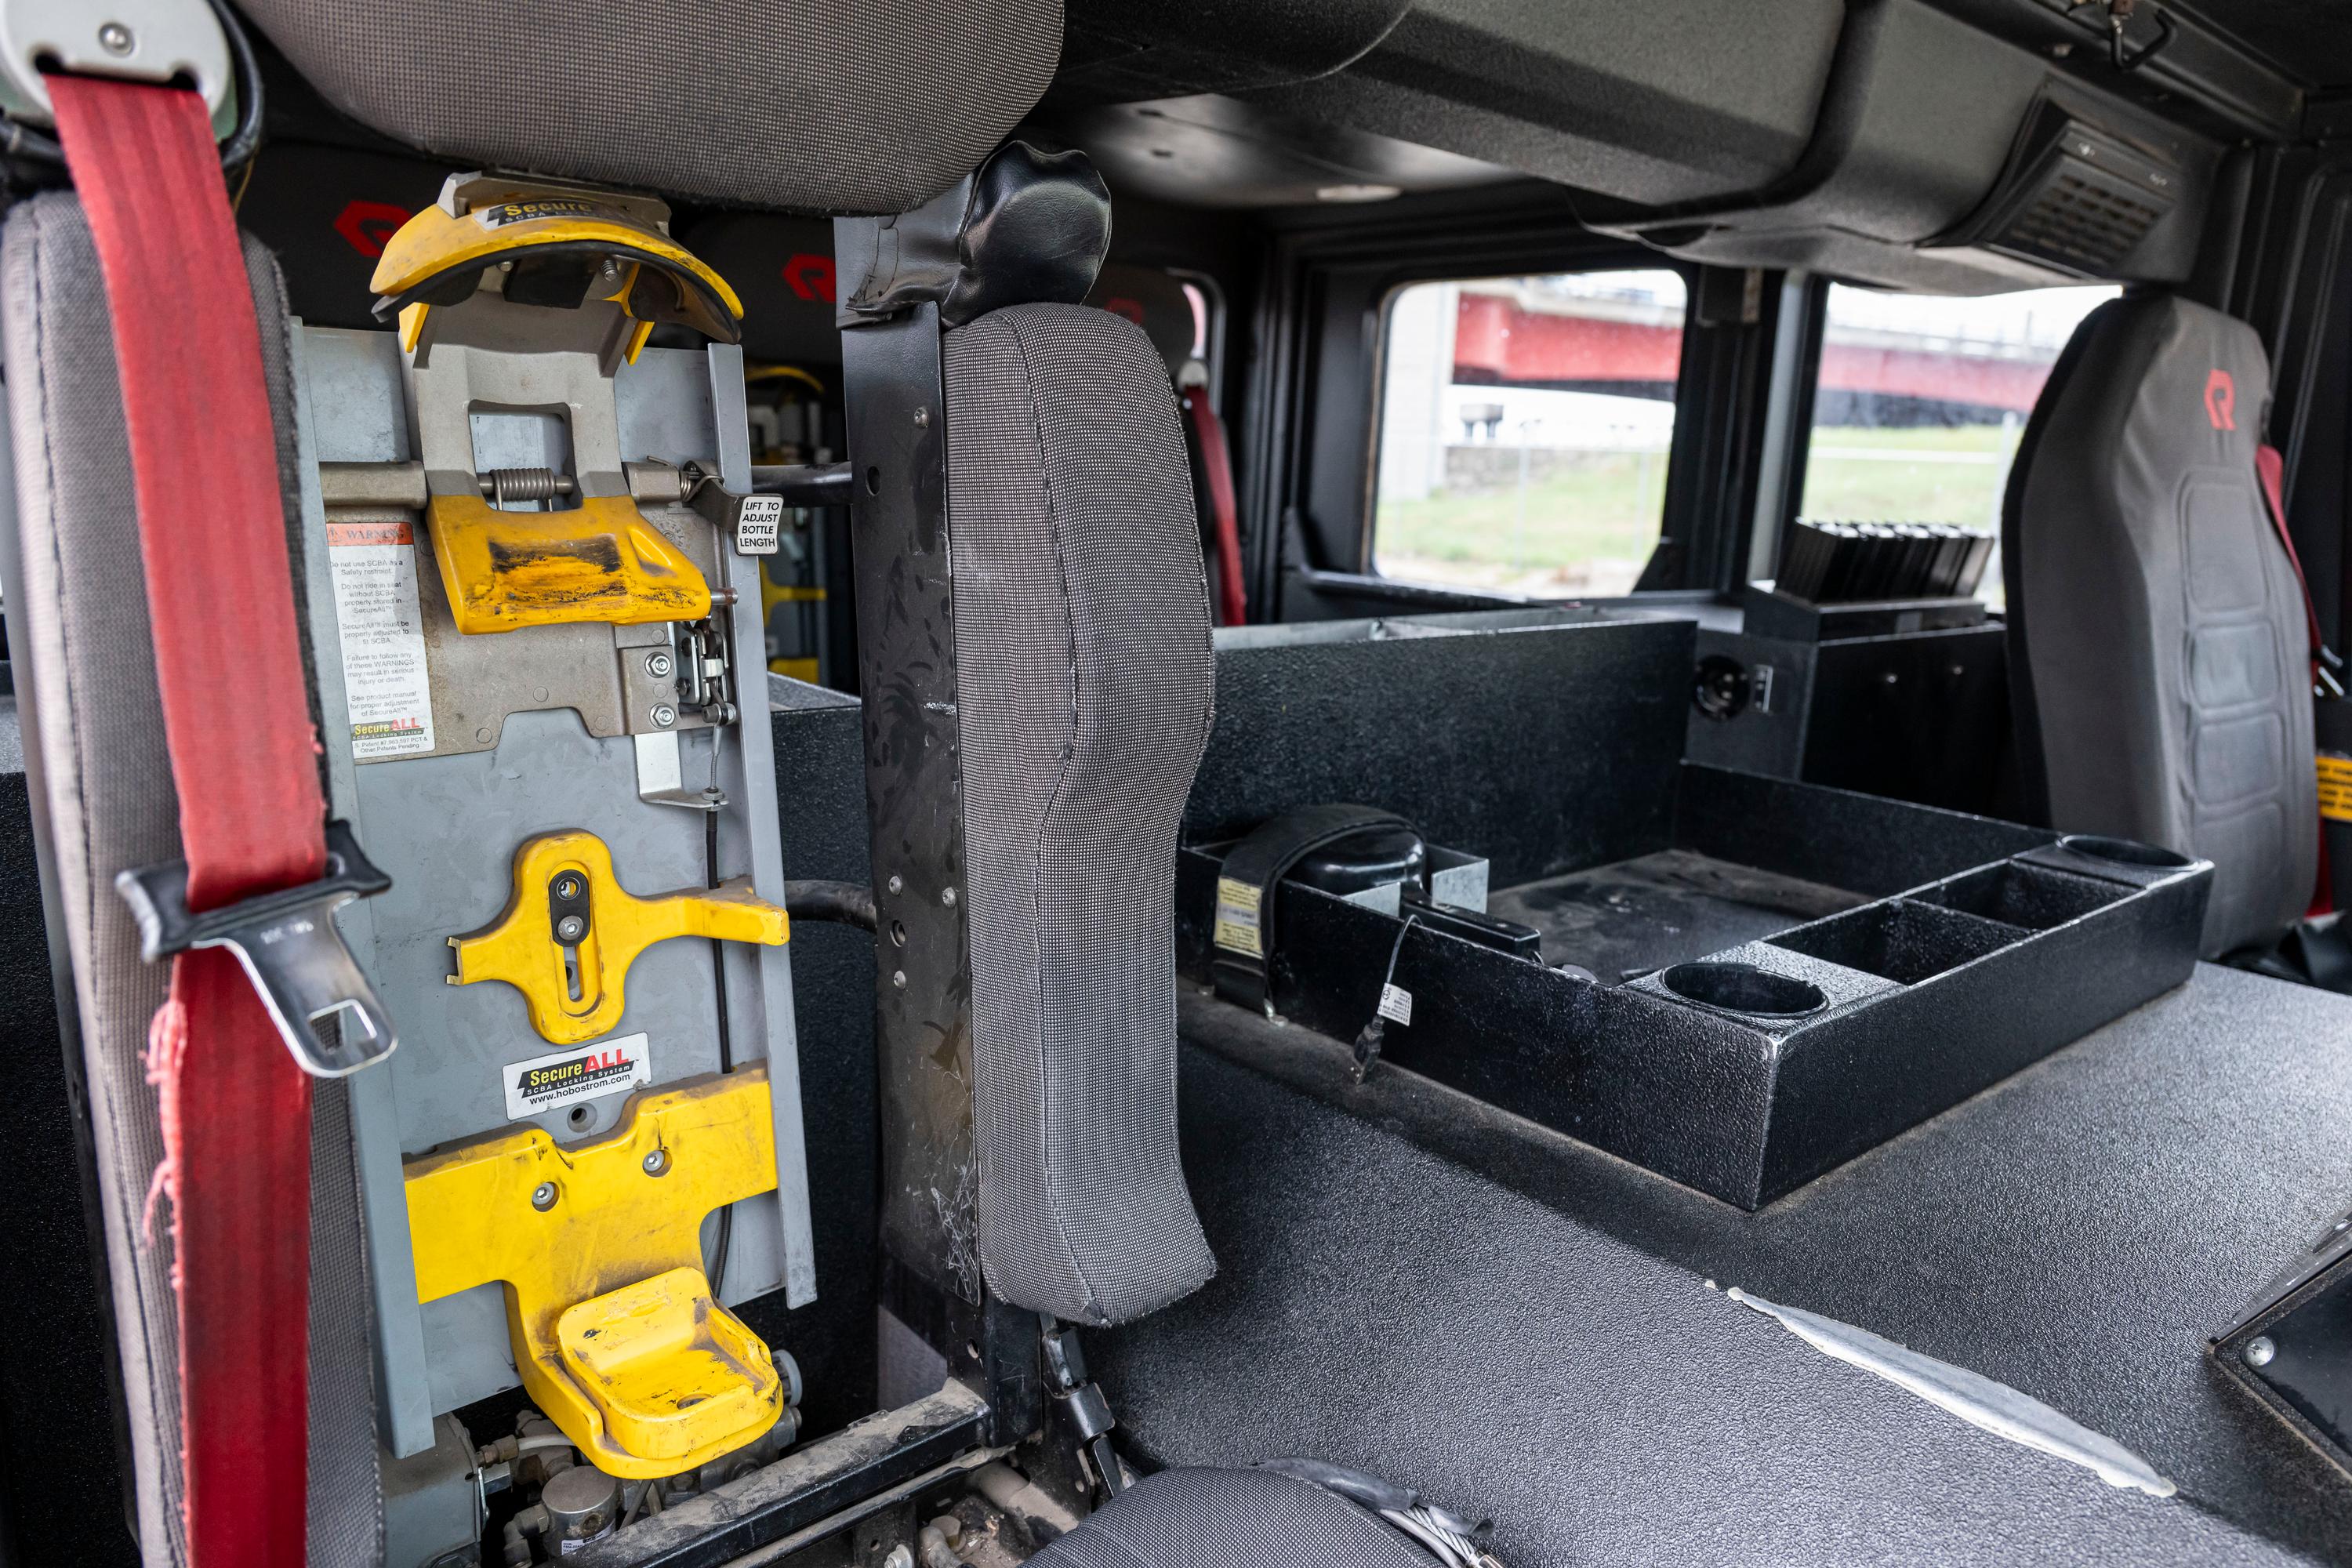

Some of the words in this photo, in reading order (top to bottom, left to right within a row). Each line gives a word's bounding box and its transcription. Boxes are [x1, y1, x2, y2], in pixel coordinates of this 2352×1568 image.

[745, 502, 763, 510] LIFT
[768, 502, 779, 510] TO
[742, 514, 778, 522] ADJUST
[347, 529, 404, 539] WARNING
[742, 525, 774, 534] BOTTLE
[739, 538, 775, 547] LENGTH
[383, 699, 420, 707] adjustment
[530, 1048, 629, 1087] SecureALL
[527, 1083, 552, 1095] SCBA
[557, 1073, 593, 1088] Locking
[598, 1065, 630, 1077] System
[529, 1073, 631, 1105] www.hobostrom.com
